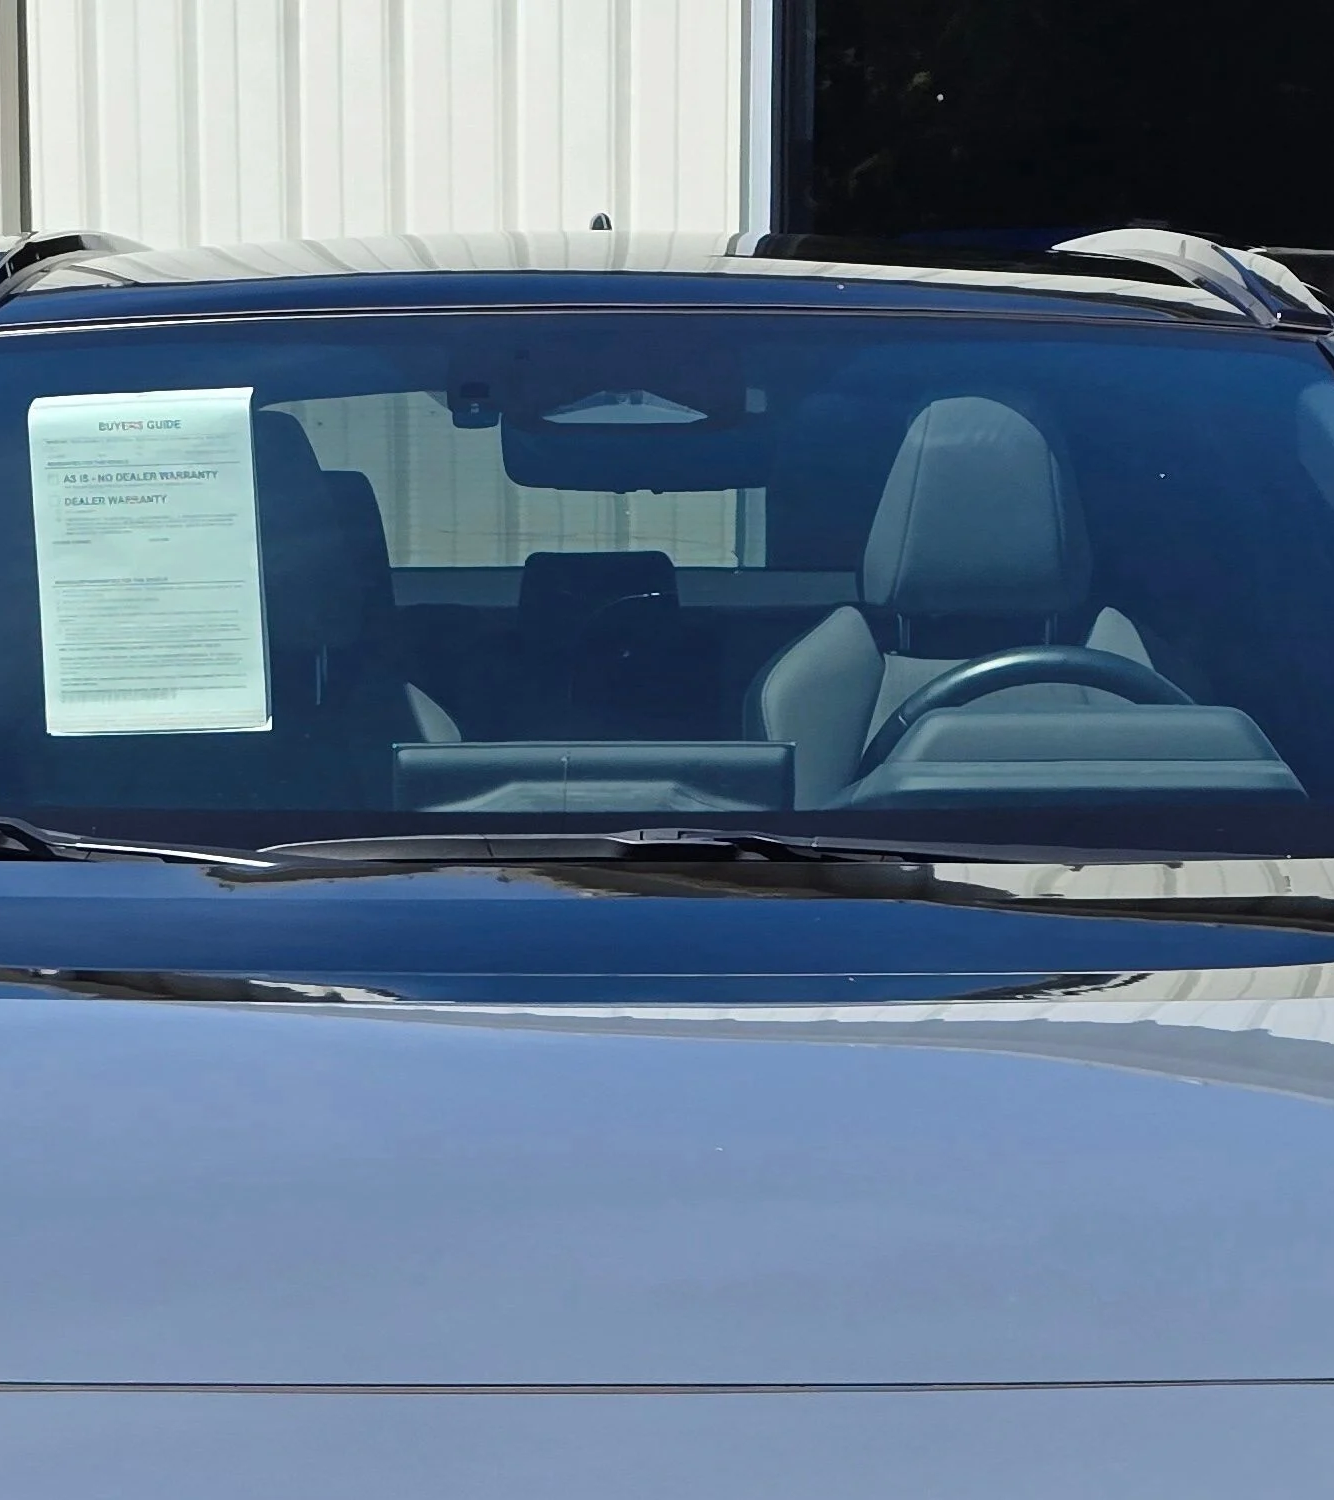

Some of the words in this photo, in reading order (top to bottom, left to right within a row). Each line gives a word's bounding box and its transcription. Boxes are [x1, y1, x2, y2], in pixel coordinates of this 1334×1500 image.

[146, 419, 182, 430] GUIDE
[63, 474, 77, 483] AS
[97, 474, 114, 483] NO
[116, 471, 157, 482] DEALER
[159, 470, 219, 481] WARRANTY
[64, 497, 106, 507] DEALER
